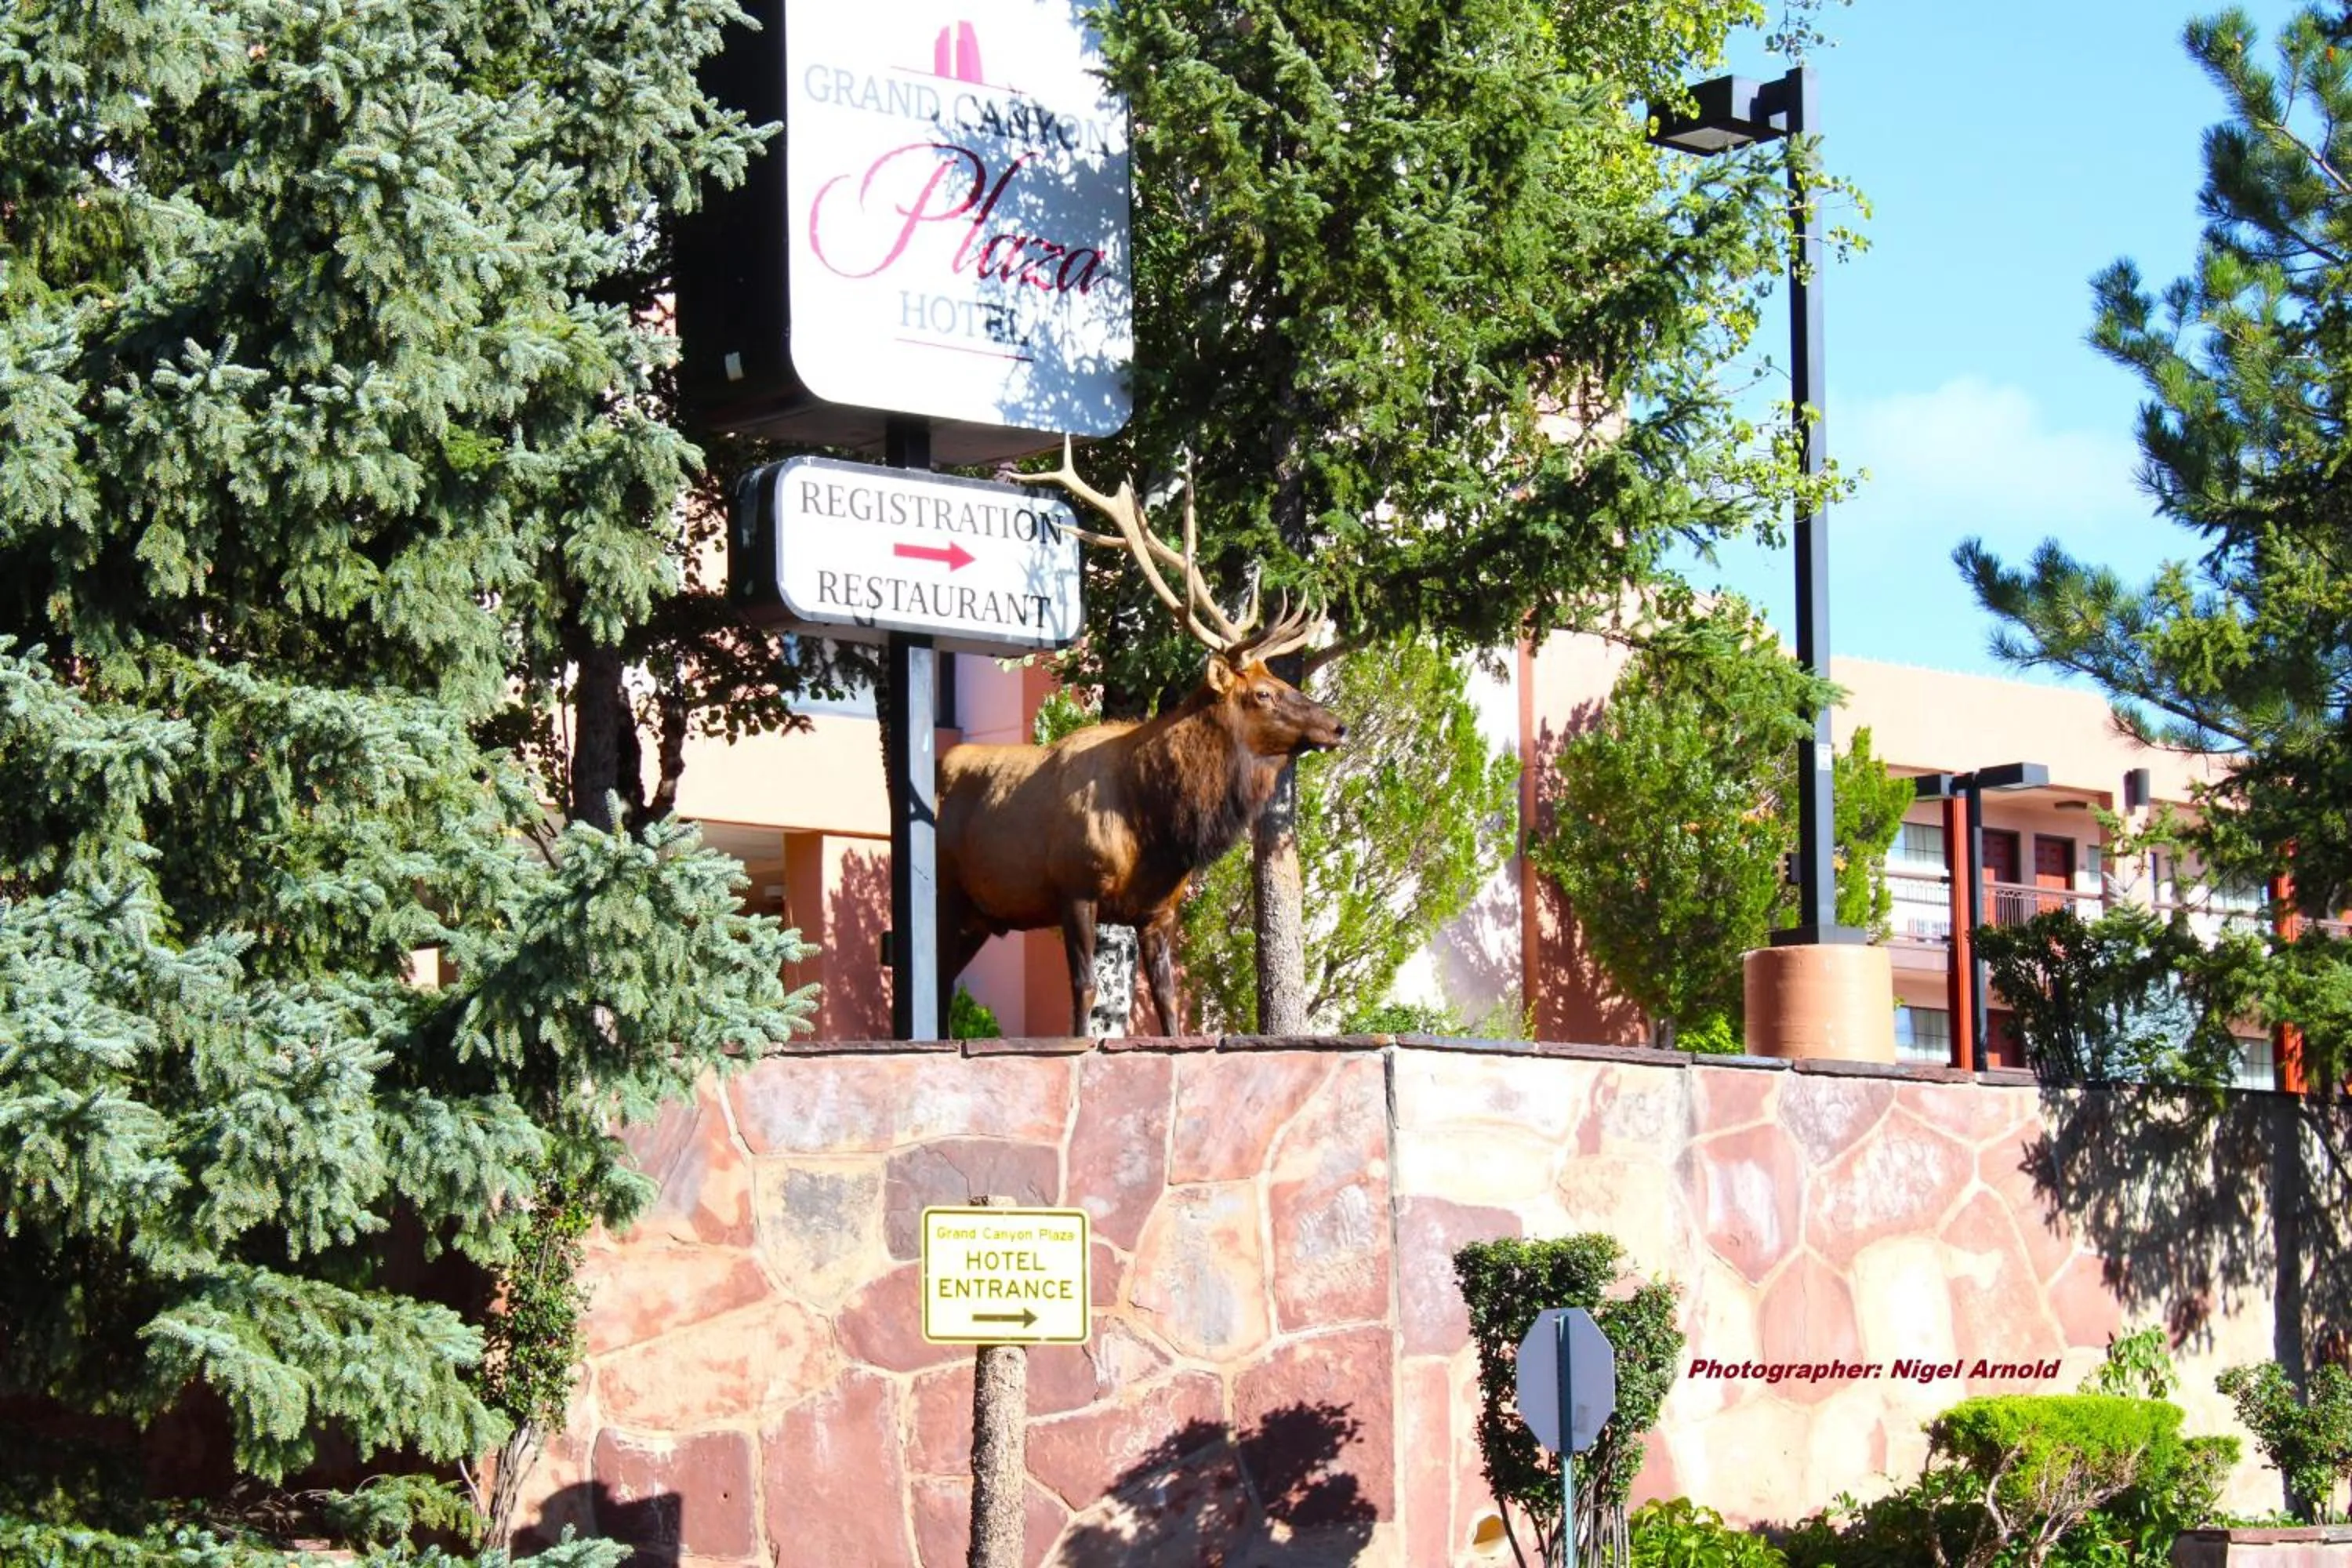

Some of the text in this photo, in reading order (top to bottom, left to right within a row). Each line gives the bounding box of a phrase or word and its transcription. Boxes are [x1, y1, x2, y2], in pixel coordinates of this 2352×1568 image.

[804, 64, 1111, 157] GRAND CANYON
[810, 143, 1110, 294] Plaza
[900, 291, 1029, 345] HOTEL
[800, 481, 1064, 546] REGISTRATION
[817, 570, 1051, 627] RESTAURANT
[936, 1227, 1075, 1242] Grand Canyon Plaza
[966, 1250, 1046, 1271] HOTEL
[938, 1279, 1073, 1299] ENTRANCE
